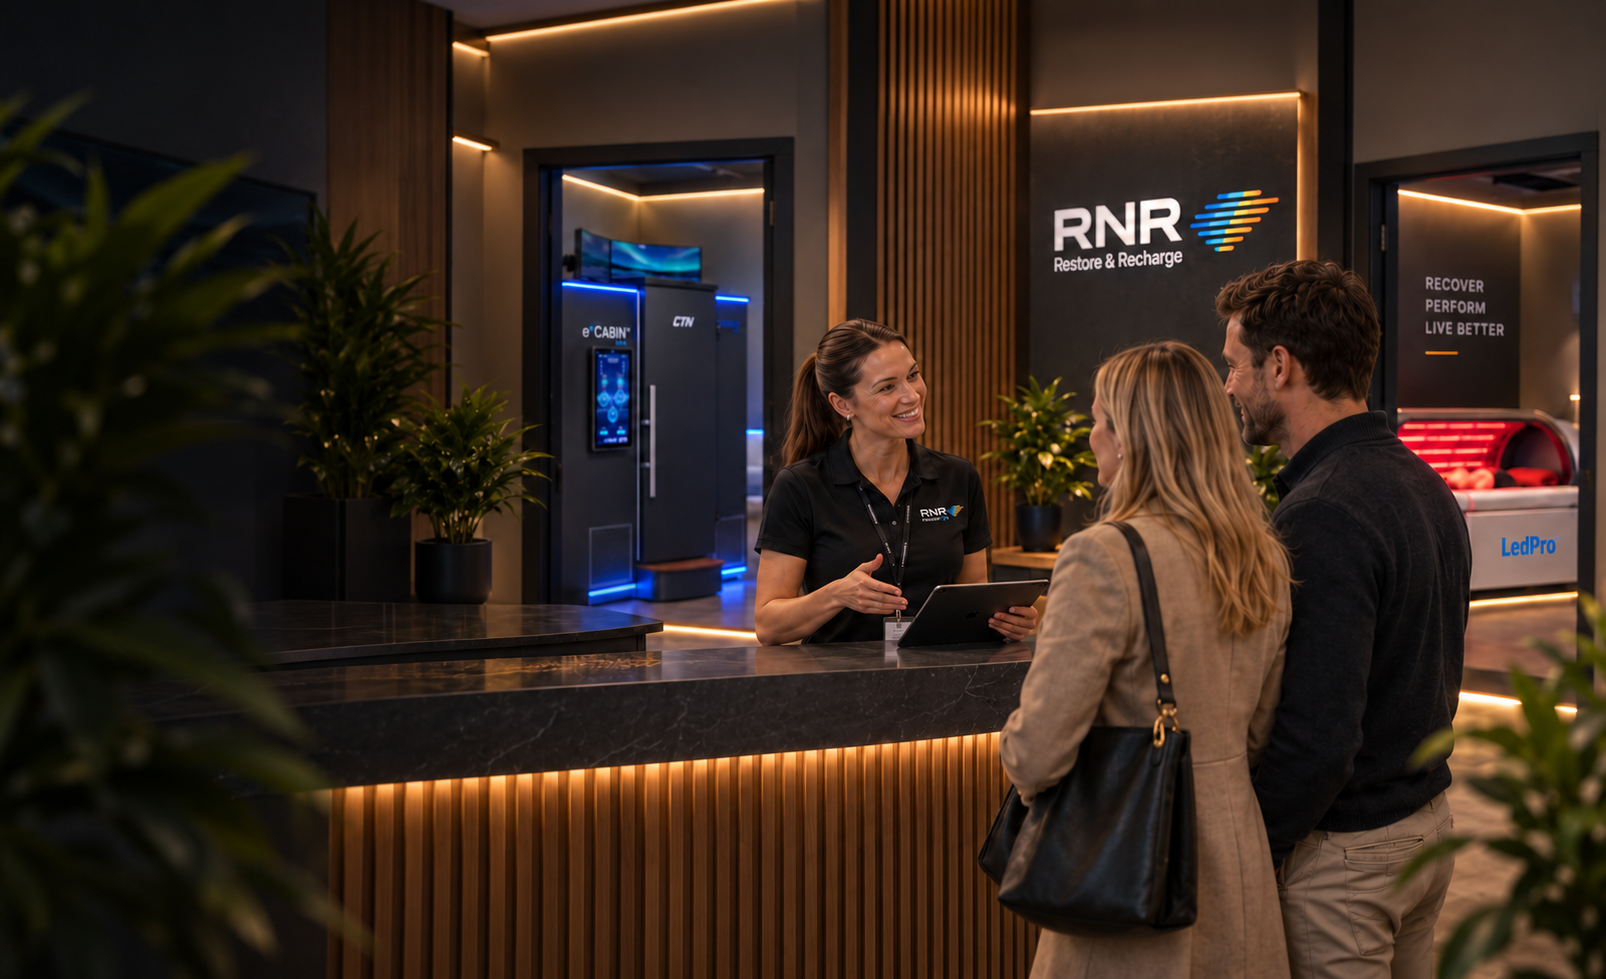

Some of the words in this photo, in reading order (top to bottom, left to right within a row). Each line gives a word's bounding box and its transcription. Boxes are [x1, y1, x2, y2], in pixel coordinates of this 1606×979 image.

[1054, 198, 1183, 252] RNR
[1054, 256, 1103, 272] Restore
[1105, 253, 1116, 269] &
[1118, 250, 1183, 268] Recharge
[1425, 276, 1484, 293] RECOVER
[1425, 299, 1486, 315] PERFORM
[1425, 321, 1453, 335] LIVE
[1457, 322, 1505, 336] BETTER
[920, 507, 948, 518] RNR
[1501, 535, 1557, 557] LedPro
